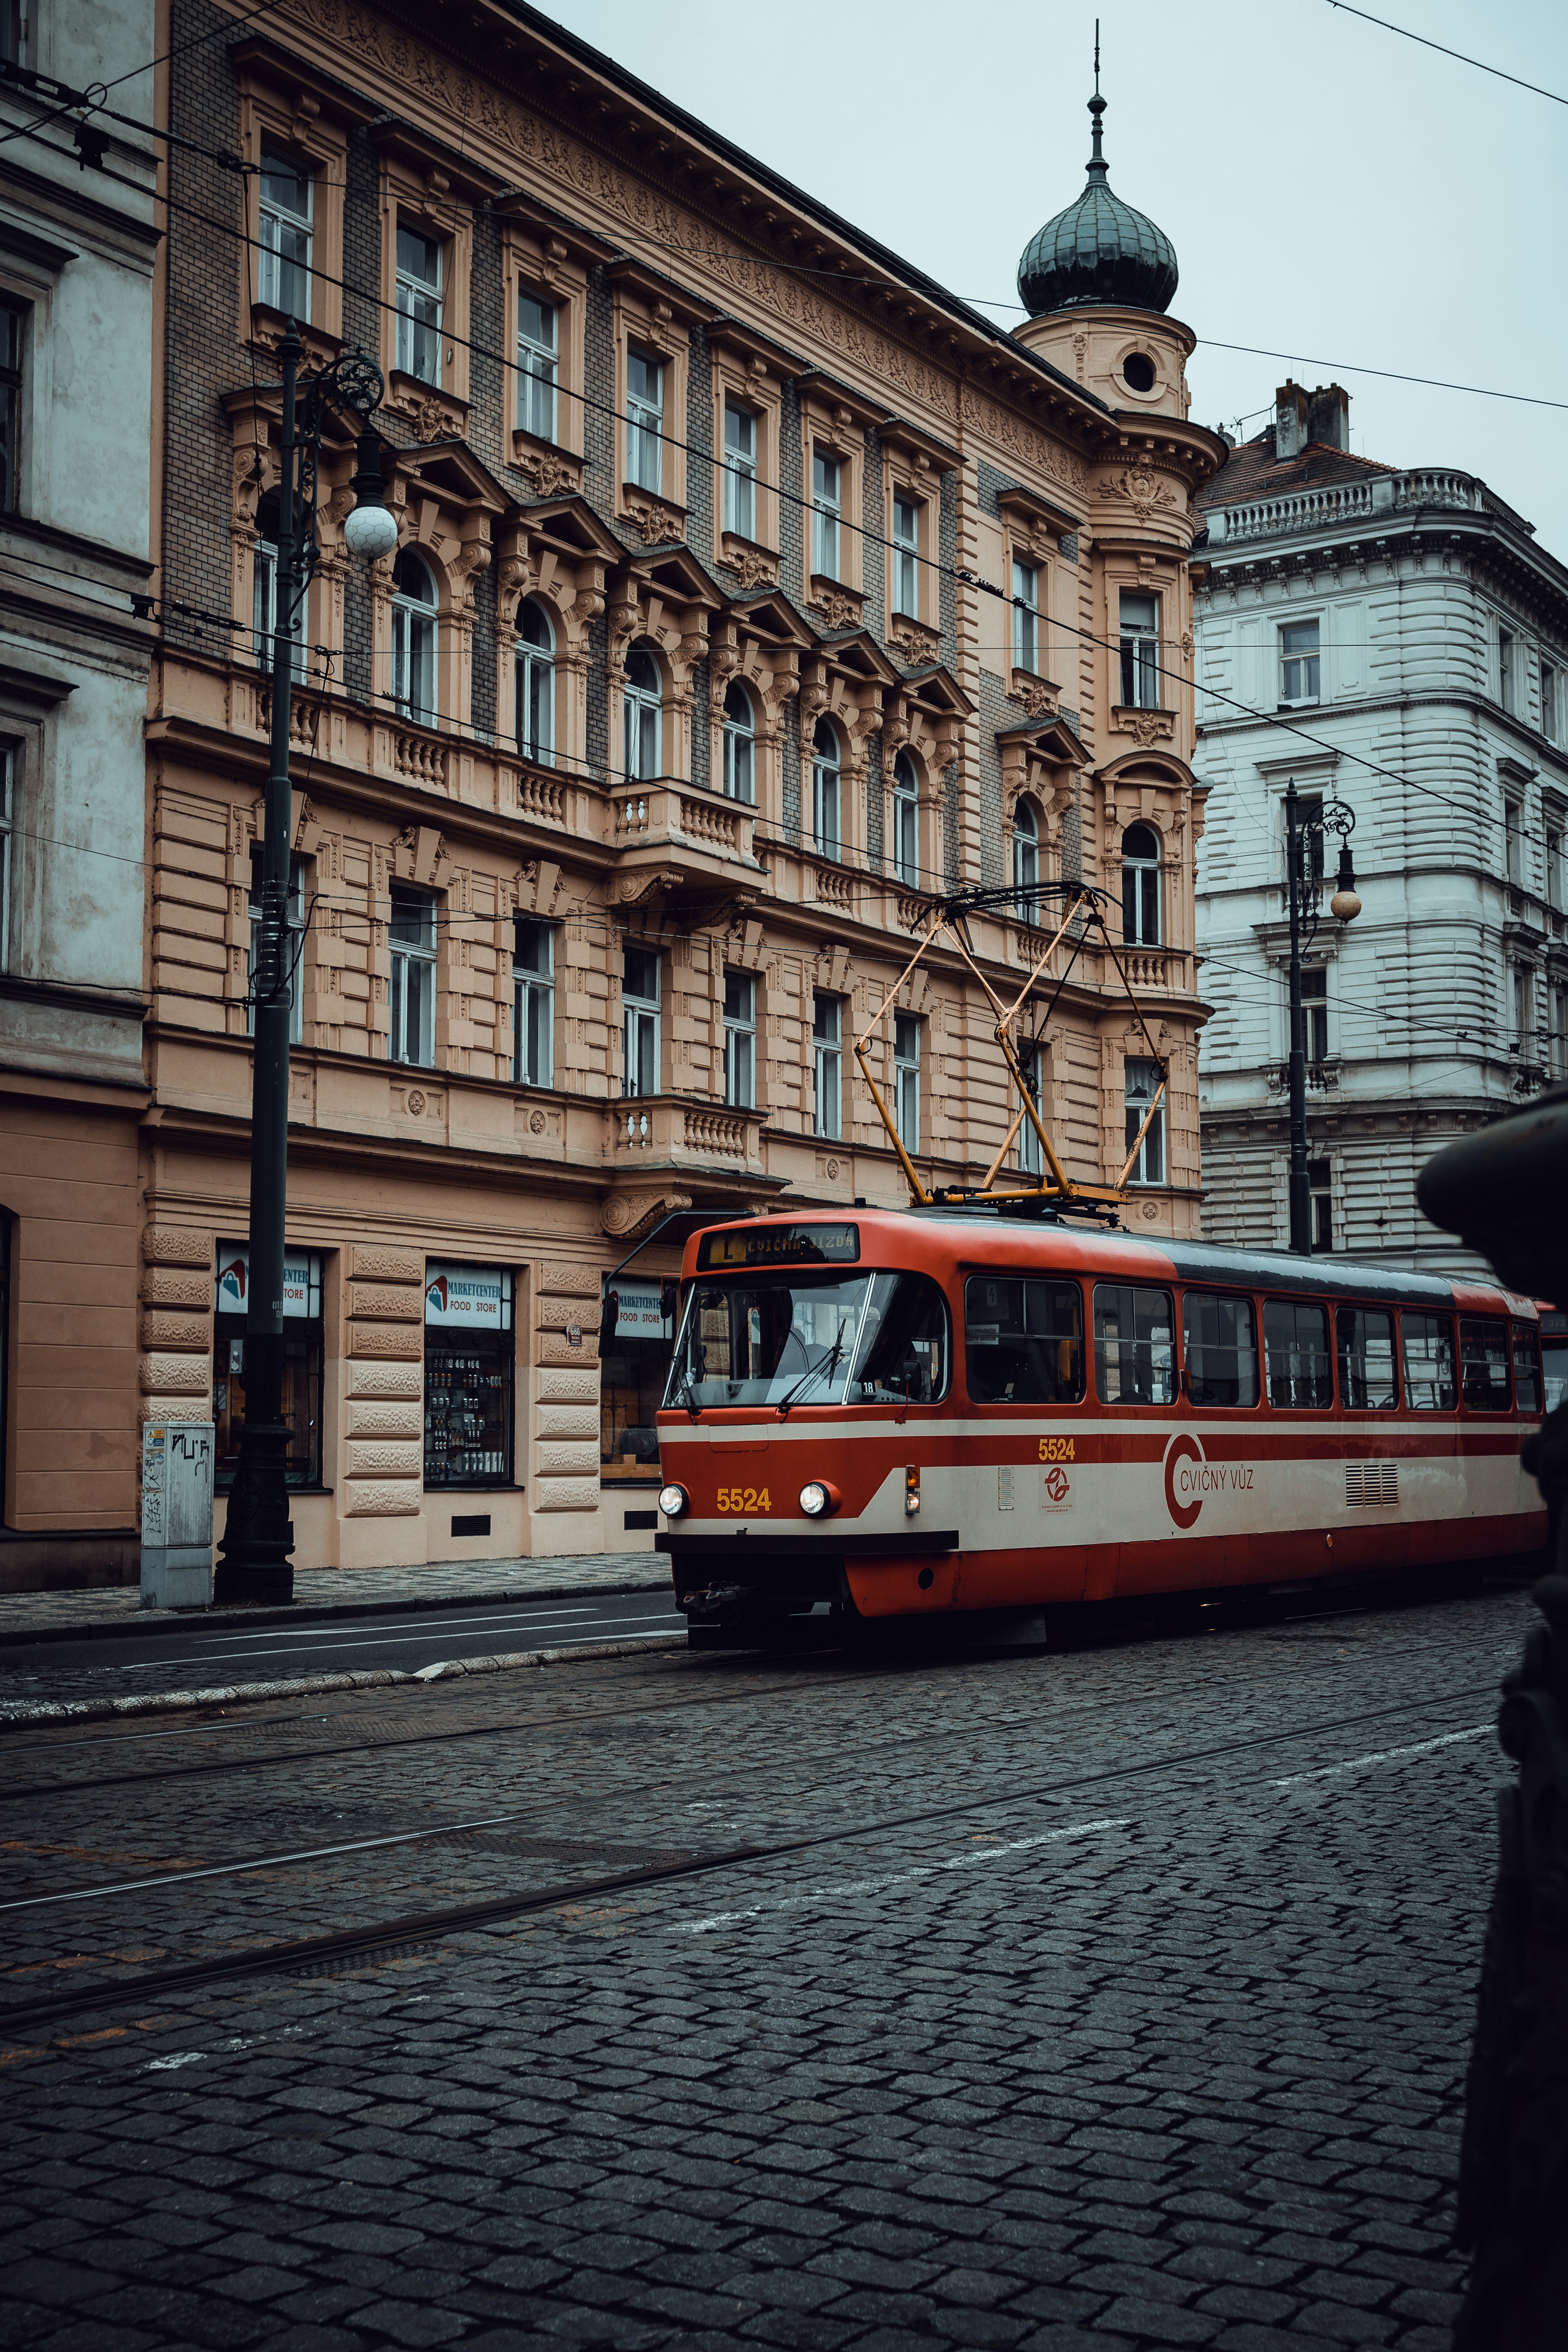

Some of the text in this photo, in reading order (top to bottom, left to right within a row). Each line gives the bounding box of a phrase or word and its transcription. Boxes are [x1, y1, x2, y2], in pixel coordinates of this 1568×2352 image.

[284, 1289, 303, 1299] TORE
[450, 1300, 497, 1313] FOOD STORE
[620, 1312, 660, 1323] FOOD STORE
[863, 1382, 873, 1393] 18
[1038, 1438, 1076, 1461] 5524
[1180, 1463, 1254, 1491] CVIČNÝ VŮZ
[716, 1488, 772, 1511] 5524
